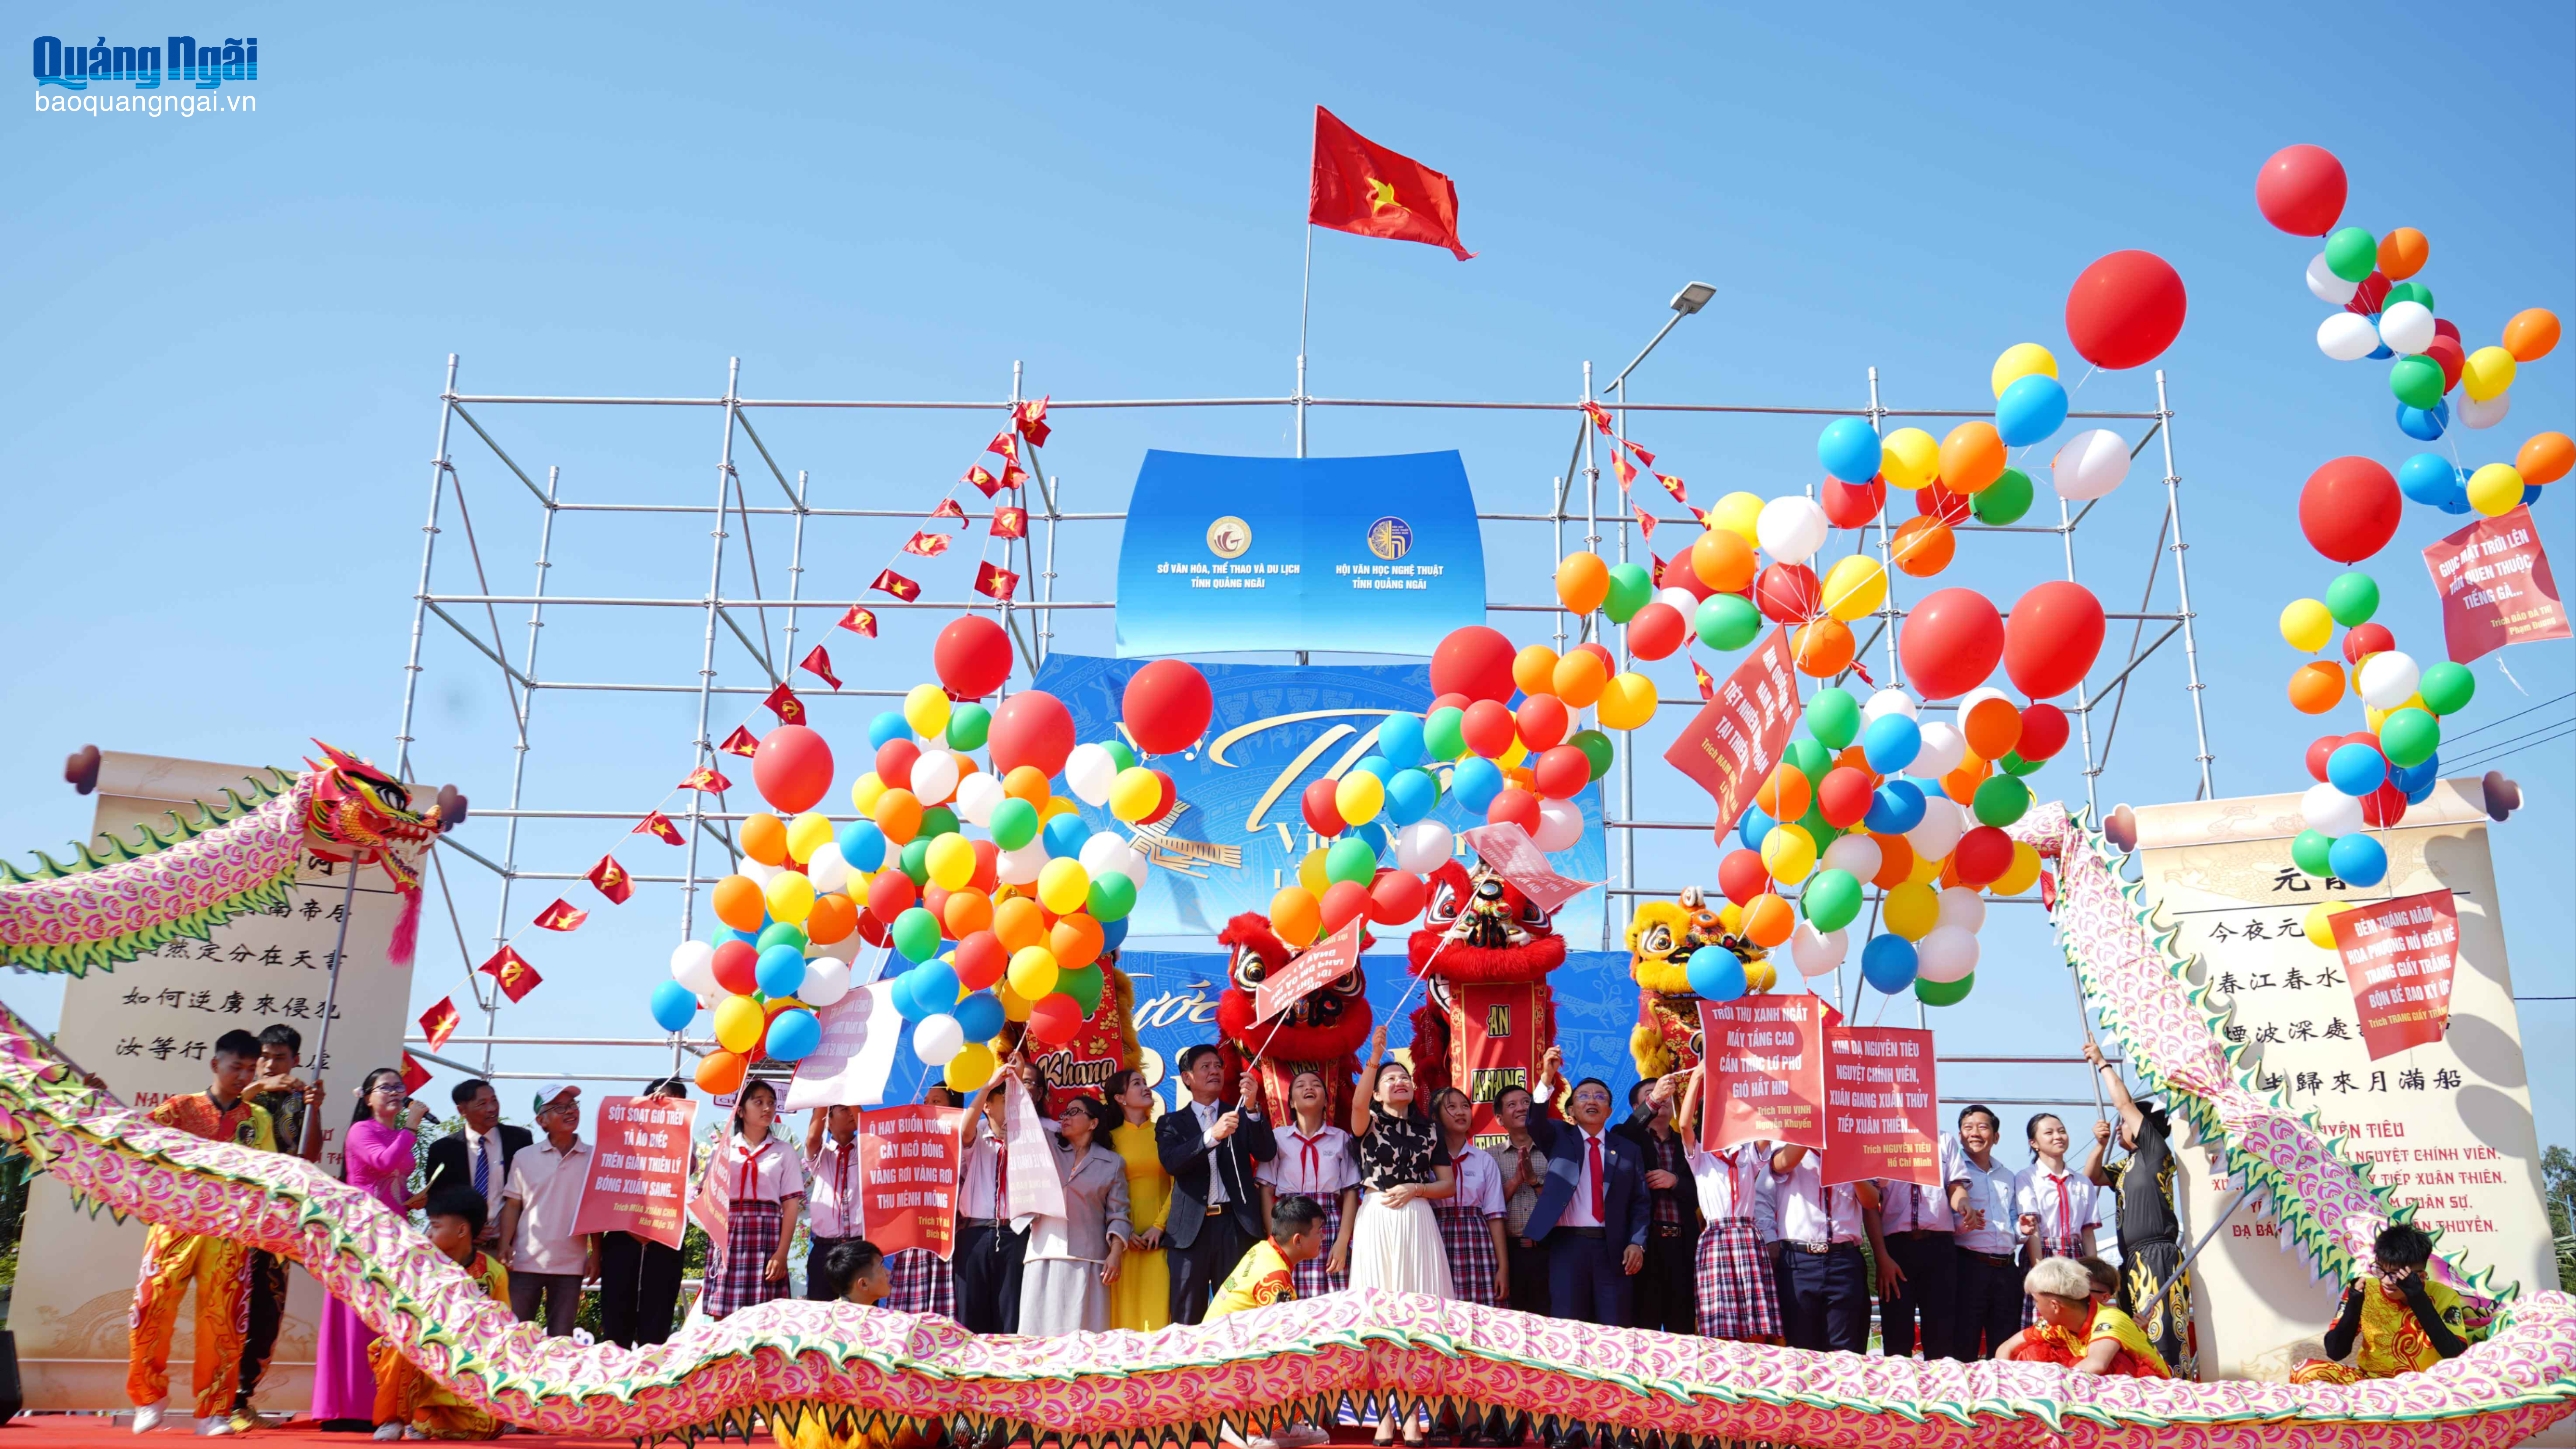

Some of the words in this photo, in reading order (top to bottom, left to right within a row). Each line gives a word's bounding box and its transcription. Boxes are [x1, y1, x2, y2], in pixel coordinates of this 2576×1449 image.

[2439, 557, 2460, 578] GIỤC
[2460, 543, 2480, 565] MẶT
[2481, 535, 2507, 557] TRỜI
[2507, 529, 2530, 548] LÊN
[1158, 562, 1170, 574] SỞ
[1171, 563, 1188, 574] VĂN
[1191, 562, 1210, 575] HÓA,
[1212, 561, 1229, 574] THỂ
[1230, 564, 1252, 574] THAO
[1254, 562, 1265, 574] VÀ
[1267, 564, 1279, 574] DU
[1281, 564, 1300, 575] LỊCH
[1336, 564, 1351, 576] HỘI
[1353, 564, 1370, 574] VĂN
[1372, 565, 1390, 576] HỌC
[1392, 564, 1415, 576] NGHỆ
[1417, 564, 1444, 577] THUẬT
[2465, 565, 2495, 585] QUEN
[2495, 554, 2532, 575] THUỘC
[1191, 576, 1211, 588] TỈNH
[1213, 576, 1242, 589] QUẢNG
[1244, 578, 1265, 588] NGÃI
[1352, 577, 1372, 589] TỈNH
[1375, 577, 1404, 589] QUẢNG
[1406, 579, 1427, 589] NGÃI
[2463, 588, 2495, 610] TIẾNG
[2490, 616, 2510, 627] Trích
[2509, 624, 2531, 635] Phạm
[1762, 645, 1777, 673] NAM
[1756, 680, 1772, 710] NAM
[1724, 680, 1744, 707] TIỆT
[1736, 698, 1760, 734] NHIÊN
[1715, 715, 1734, 740] TẠI
[1728, 730, 1749, 764] THIÊN
[1701, 737, 1718, 759] Trích
[1716, 754, 1732, 775] NAM
[2354, 918, 2378, 937] ĐÊM
[2377, 910, 2409, 931] THÁNG
[2409, 906, 2434, 924] NĂM
[2346, 947, 2368, 965] HOA
[2405, 930, 2421, 951] NỞ
[2421, 929, 2443, 948] BÊN
[2444, 924, 2456, 943] HÈ
[135, 939, 348, 972] 然定分在天書
[2365, 965, 2396, 985] TRANG
[2396, 956, 2418, 977] GIẤY
[2419, 952, 2452, 975] TRẮNG
[2368, 988, 2391, 1010] BỘN
[2404, 986, 2424, 1002] BAO
[2423, 980, 2438, 999] KÝ
[1487, 1005, 1510, 1037] AN
[1712, 1005, 1734, 1020] TRỜI
[1735, 1007, 1751, 1022] THU
[1754, 1007, 1779, 1022] XANH
[1782, 1003, 1808, 1021] NGẮT
[2368, 1017, 2388, 1028] Trích
[2388, 1012, 2411, 1024] TRANG
[2412, 1008, 2427, 1021] GIẤY
[1775, 1031, 1794, 1046] CAO
[1831, 1040, 1849, 1054] KIM
[1850, 1040, 1863, 1058] DẠ
[1864, 1039, 1898, 1057] NGUYÊN
[1900, 1039, 1919, 1057] TIÊU
[1036, 1051, 1116, 1090] Khang
[1836, 1063, 1866, 1084] NGUYỆT
[1867, 1065, 1894, 1083] CHÍNH
[1895, 1065, 1920, 1084] VIÊN,
[1732, 1080, 1749, 1098] GIÓ
[1751, 1076, 1769, 1097] HẮT
[1772, 1080, 1789, 1095] HIU
[1830, 1088, 1851, 1107] XUÂN
[1852, 1092, 1876, 1108] GIANG
[1879, 1090, 1904, 1108] XUÂN
[1906, 1088, 1929, 1108] THỦY
[608, 1104, 625, 1124] SỘT
[627, 1108, 650, 1125] SOẠT
[651, 1107, 665, 1124] GIÓ
[666, 1109, 686, 1126] TRÊU
[1758, 1106, 1775, 1116] Trích
[1777, 1106, 1791, 1115] THU
[1793, 1105, 1812, 1116] VỊNH
[878, 1119, 896, 1136] HAY
[924, 1118, 951, 1135] VƯƠNG
[1755, 1118, 1782, 1131] Nguyễn
[1784, 1117, 1812, 1129] Khuyến
[1837, 1113, 1855, 1133] TIẾP
[1855, 1116, 1880, 1134] XUÂN
[2366, 1120, 2404, 1138] TIÊU
[636, 1129, 647, 1146] ÁO
[649, 1130, 668, 1149] BIẾC
[880, 1141, 899, 1159] CÂY
[901, 1139, 919, 1158] NGÔ
[1863, 1144, 1881, 1154] Trích
[1883, 1142, 1913, 1153] NGUYÊN
[1915, 1142, 1931, 1153] TIÊU
[601, 1153, 624, 1169] TRÊN
[625, 1154, 647, 1171] GIÀN
[648, 1155, 672, 1174] THIÊN
[672, 1157, 682, 1174] LÝ
[1913, 1157, 1932, 1167] Minh
[2414, 1146, 2459, 1161] CHÍNH
[870, 1166, 896, 1184] VÀNG
[898, 1167, 912, 1182] RƠI
[914, 1164, 938, 1182] VÀNG
[939, 1168, 953, 1184] RƠI
[2416, 1170, 2455, 1185] XUÂN
[595, 1175, 623, 1192] BÓNG
[622, 1178, 648, 1195] XUÂN
[613, 1202, 629, 1211] Trích
[877, 1193, 895, 1209] THU
[897, 1189, 921, 1208] MÊNH
[924, 1189, 948, 1208] MÔNG
[918, 1216, 935, 1225] Trích
[2232, 1224, 2252, 1239] DẠ
